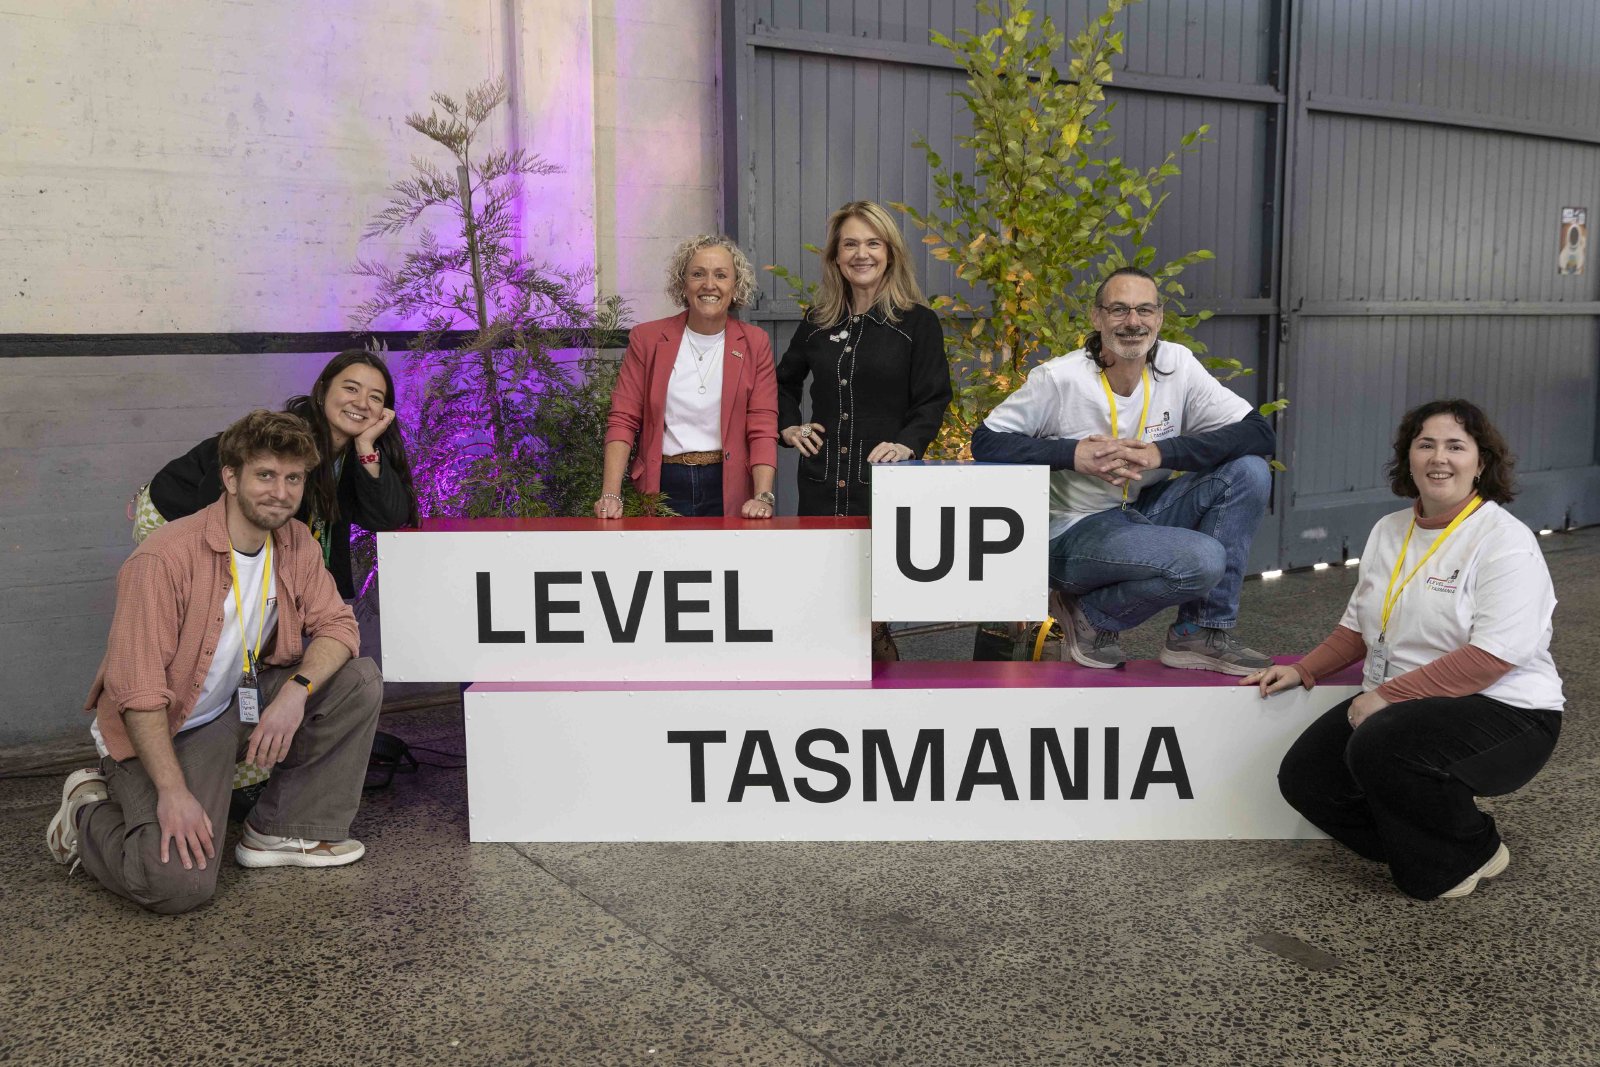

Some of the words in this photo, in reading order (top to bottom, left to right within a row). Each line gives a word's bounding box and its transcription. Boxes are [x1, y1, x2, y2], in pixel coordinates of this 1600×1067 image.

[895, 506, 1025, 583] UP
[475, 570, 774, 644] LEVEL
[667, 726, 1195, 804] TASMANIA
